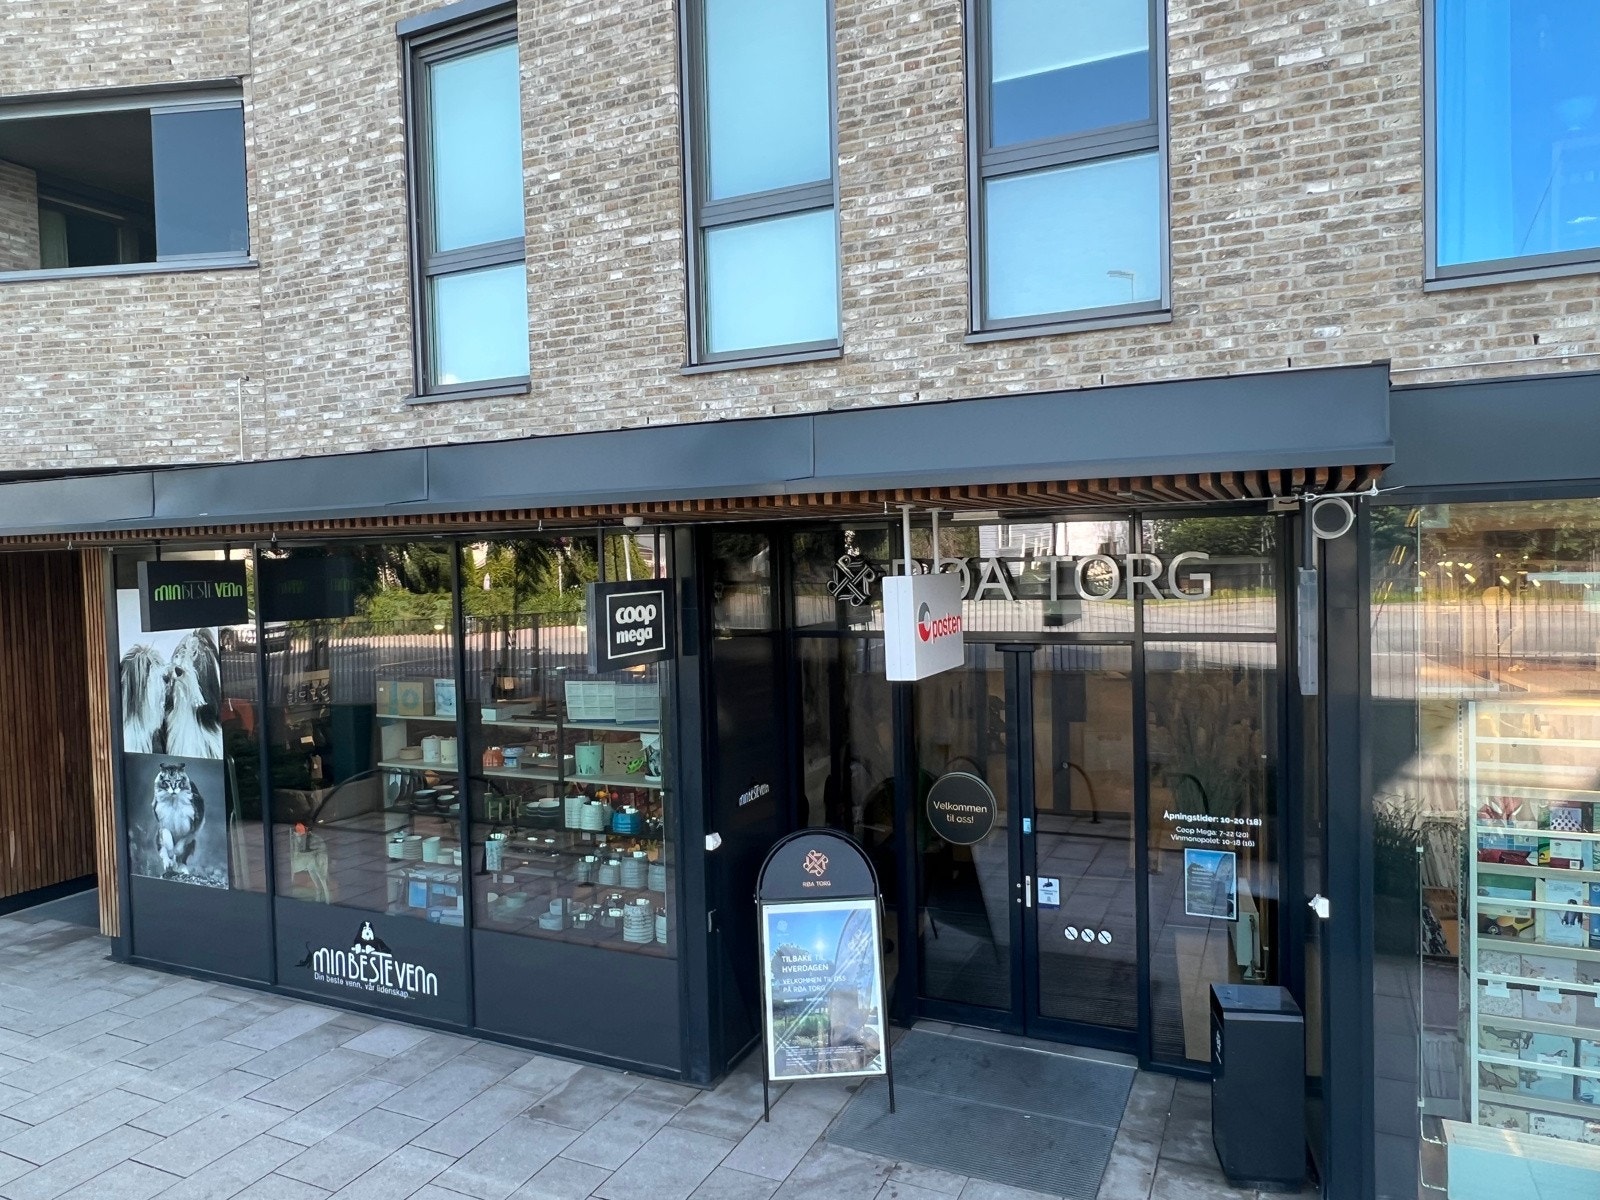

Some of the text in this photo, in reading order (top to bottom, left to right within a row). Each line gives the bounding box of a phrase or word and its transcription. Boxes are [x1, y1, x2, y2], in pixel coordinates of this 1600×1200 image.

[1034, 551, 1212, 601] TORG
[615, 604, 657, 625] coop
[931, 612, 962, 644] posten
[616, 627, 653, 646] mega
[933, 800, 988, 813] Velkommen
[946, 814, 975, 824] til oss!
[1163, 810, 1262, 826] Åpningstider: 10-20 (18)
[1175, 826, 1195, 834] Coop
[781, 955, 812, 963] TILBAKE
[782, 963, 829, 973] HVERDAGEN
[314, 972, 325, 981] Din
[326, 974, 343, 985] beste
[365, 982, 375, 991] vår
[783, 976, 822, 985] VELKOMMEN
